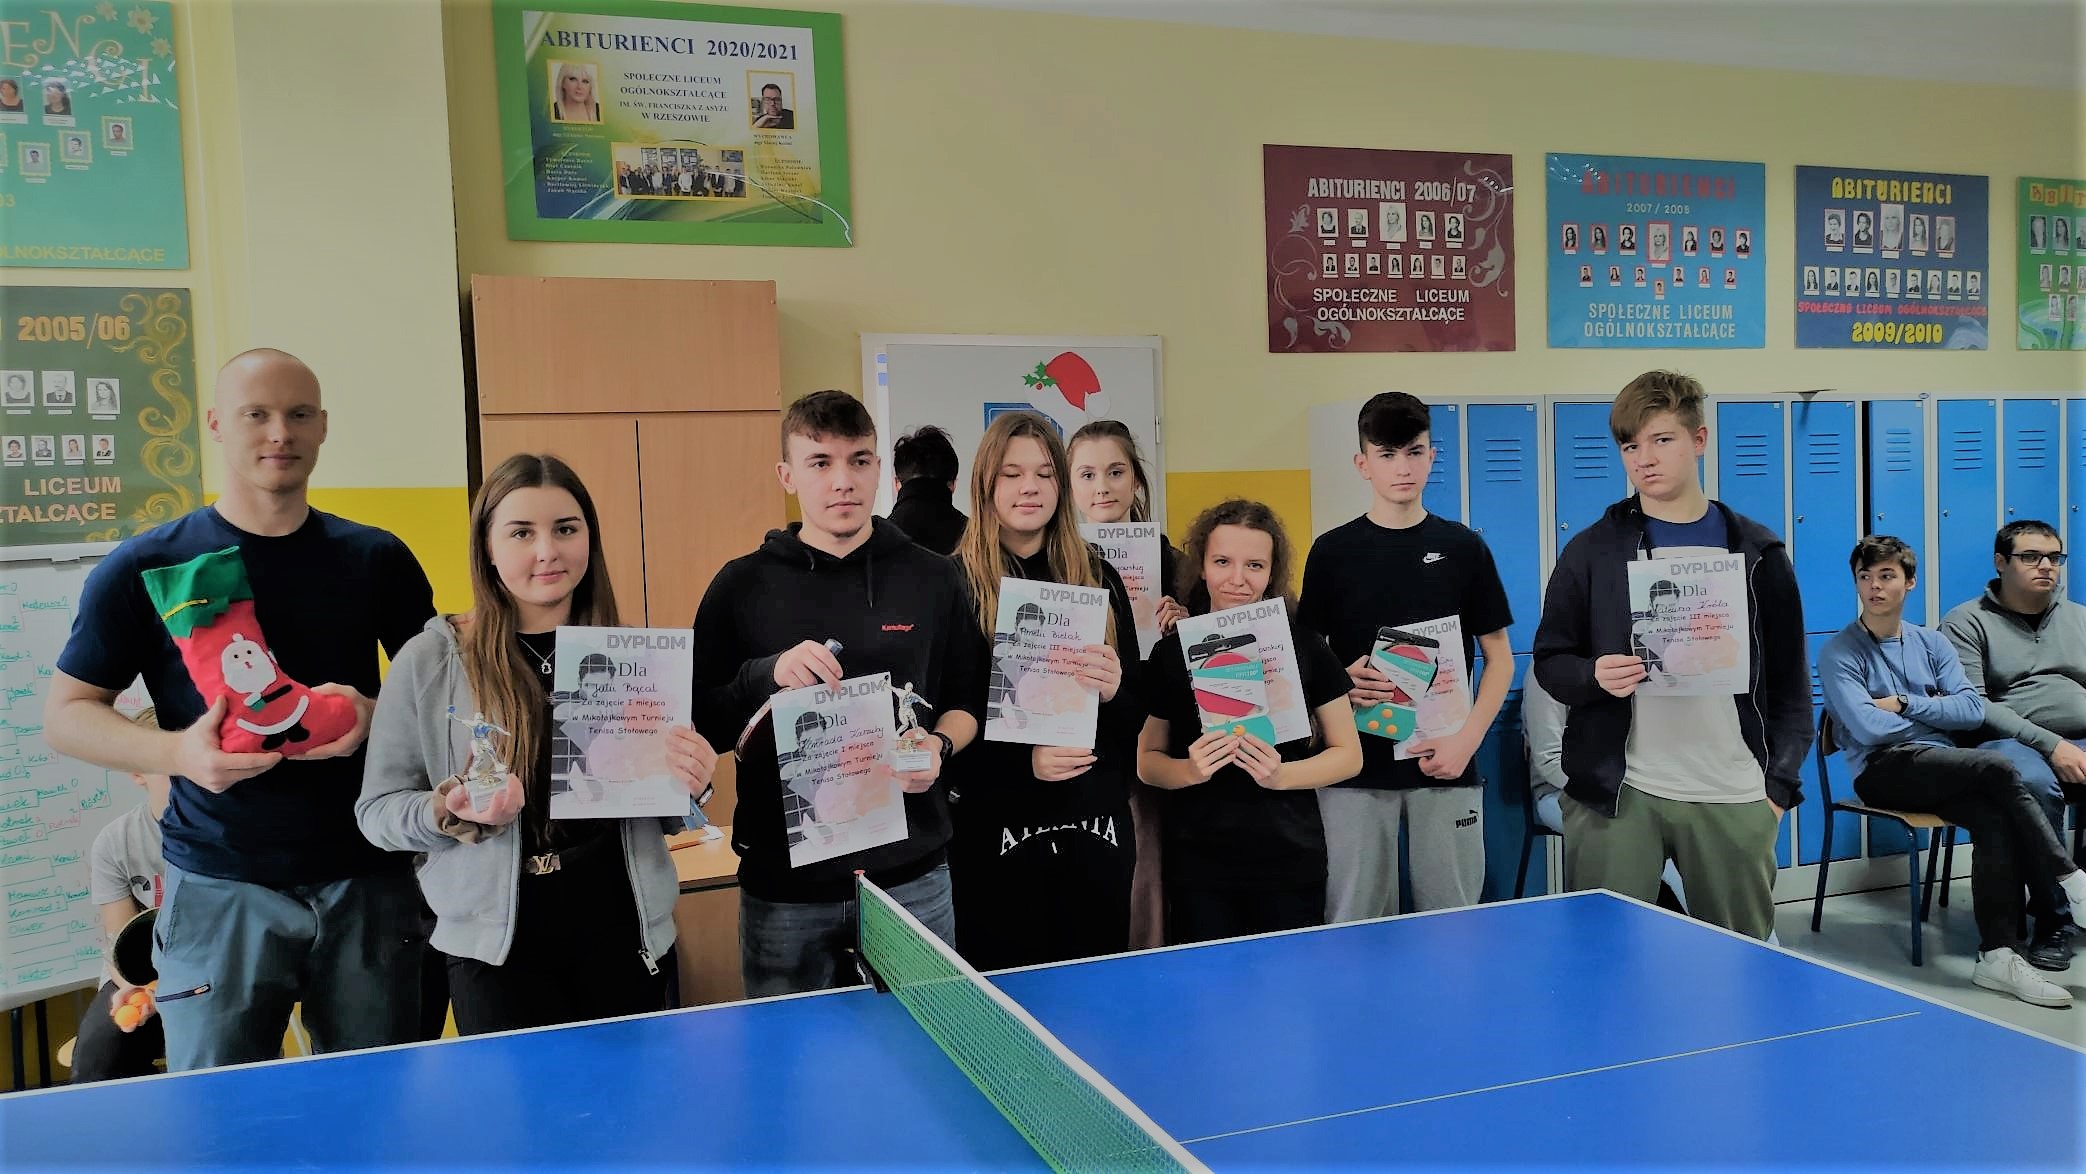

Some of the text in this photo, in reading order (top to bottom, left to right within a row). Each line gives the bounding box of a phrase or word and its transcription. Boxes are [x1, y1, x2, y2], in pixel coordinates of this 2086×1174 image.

[542, 30, 798, 61] ABITURIENCI 2020/2021
[683, 75, 721, 85] LICEUM
[1307, 176, 1477, 208] ABITURIENCI 2006/07
[1831, 176, 1953, 204] ABITURIENCI
[1313, 288, 1470, 303] SPOŁECZNE LICEUM
[1317, 303, 1465, 325] OGÓLNOKSZTAŁCĄCE
[1588, 303, 1733, 320] SPOŁECZNE LICEUM
[1856, 302, 1893, 315] LICEUM
[18, 313, 131, 350] 2005/06
[1584, 317, 1736, 340] OGÓLNOKSZTAŁCĄCE
[1851, 321, 1944, 345] 2009/2010
[24, 476, 121, 496] LICEUM
[1097, 527, 1155, 539] DYPLOM
[1107, 548, 1128, 560] Dla
[1670, 559, 1739, 576] DYPLOM
[1039, 587, 1103, 607] DYPLOM
[1683, 584, 1707, 597] Dla
[1047, 612, 1070, 627] Dla
[1216, 604, 1281, 629] DYPLOM
[1412, 621, 1457, 637] DYPLOM
[606, 634, 687, 650] DYPLOM
[618, 661, 647, 677] Dla
[814, 680, 885, 705] DYPLOM
[596, 699, 624, 707] zajęcie
[636, 699, 666, 708] miejsca
[582, 713, 638, 723] Mikołajkowym
[641, 714, 674, 723] Turnieju
[824, 713, 848, 729] Dla
[588, 726, 658, 736] Tenisa Stołowego
